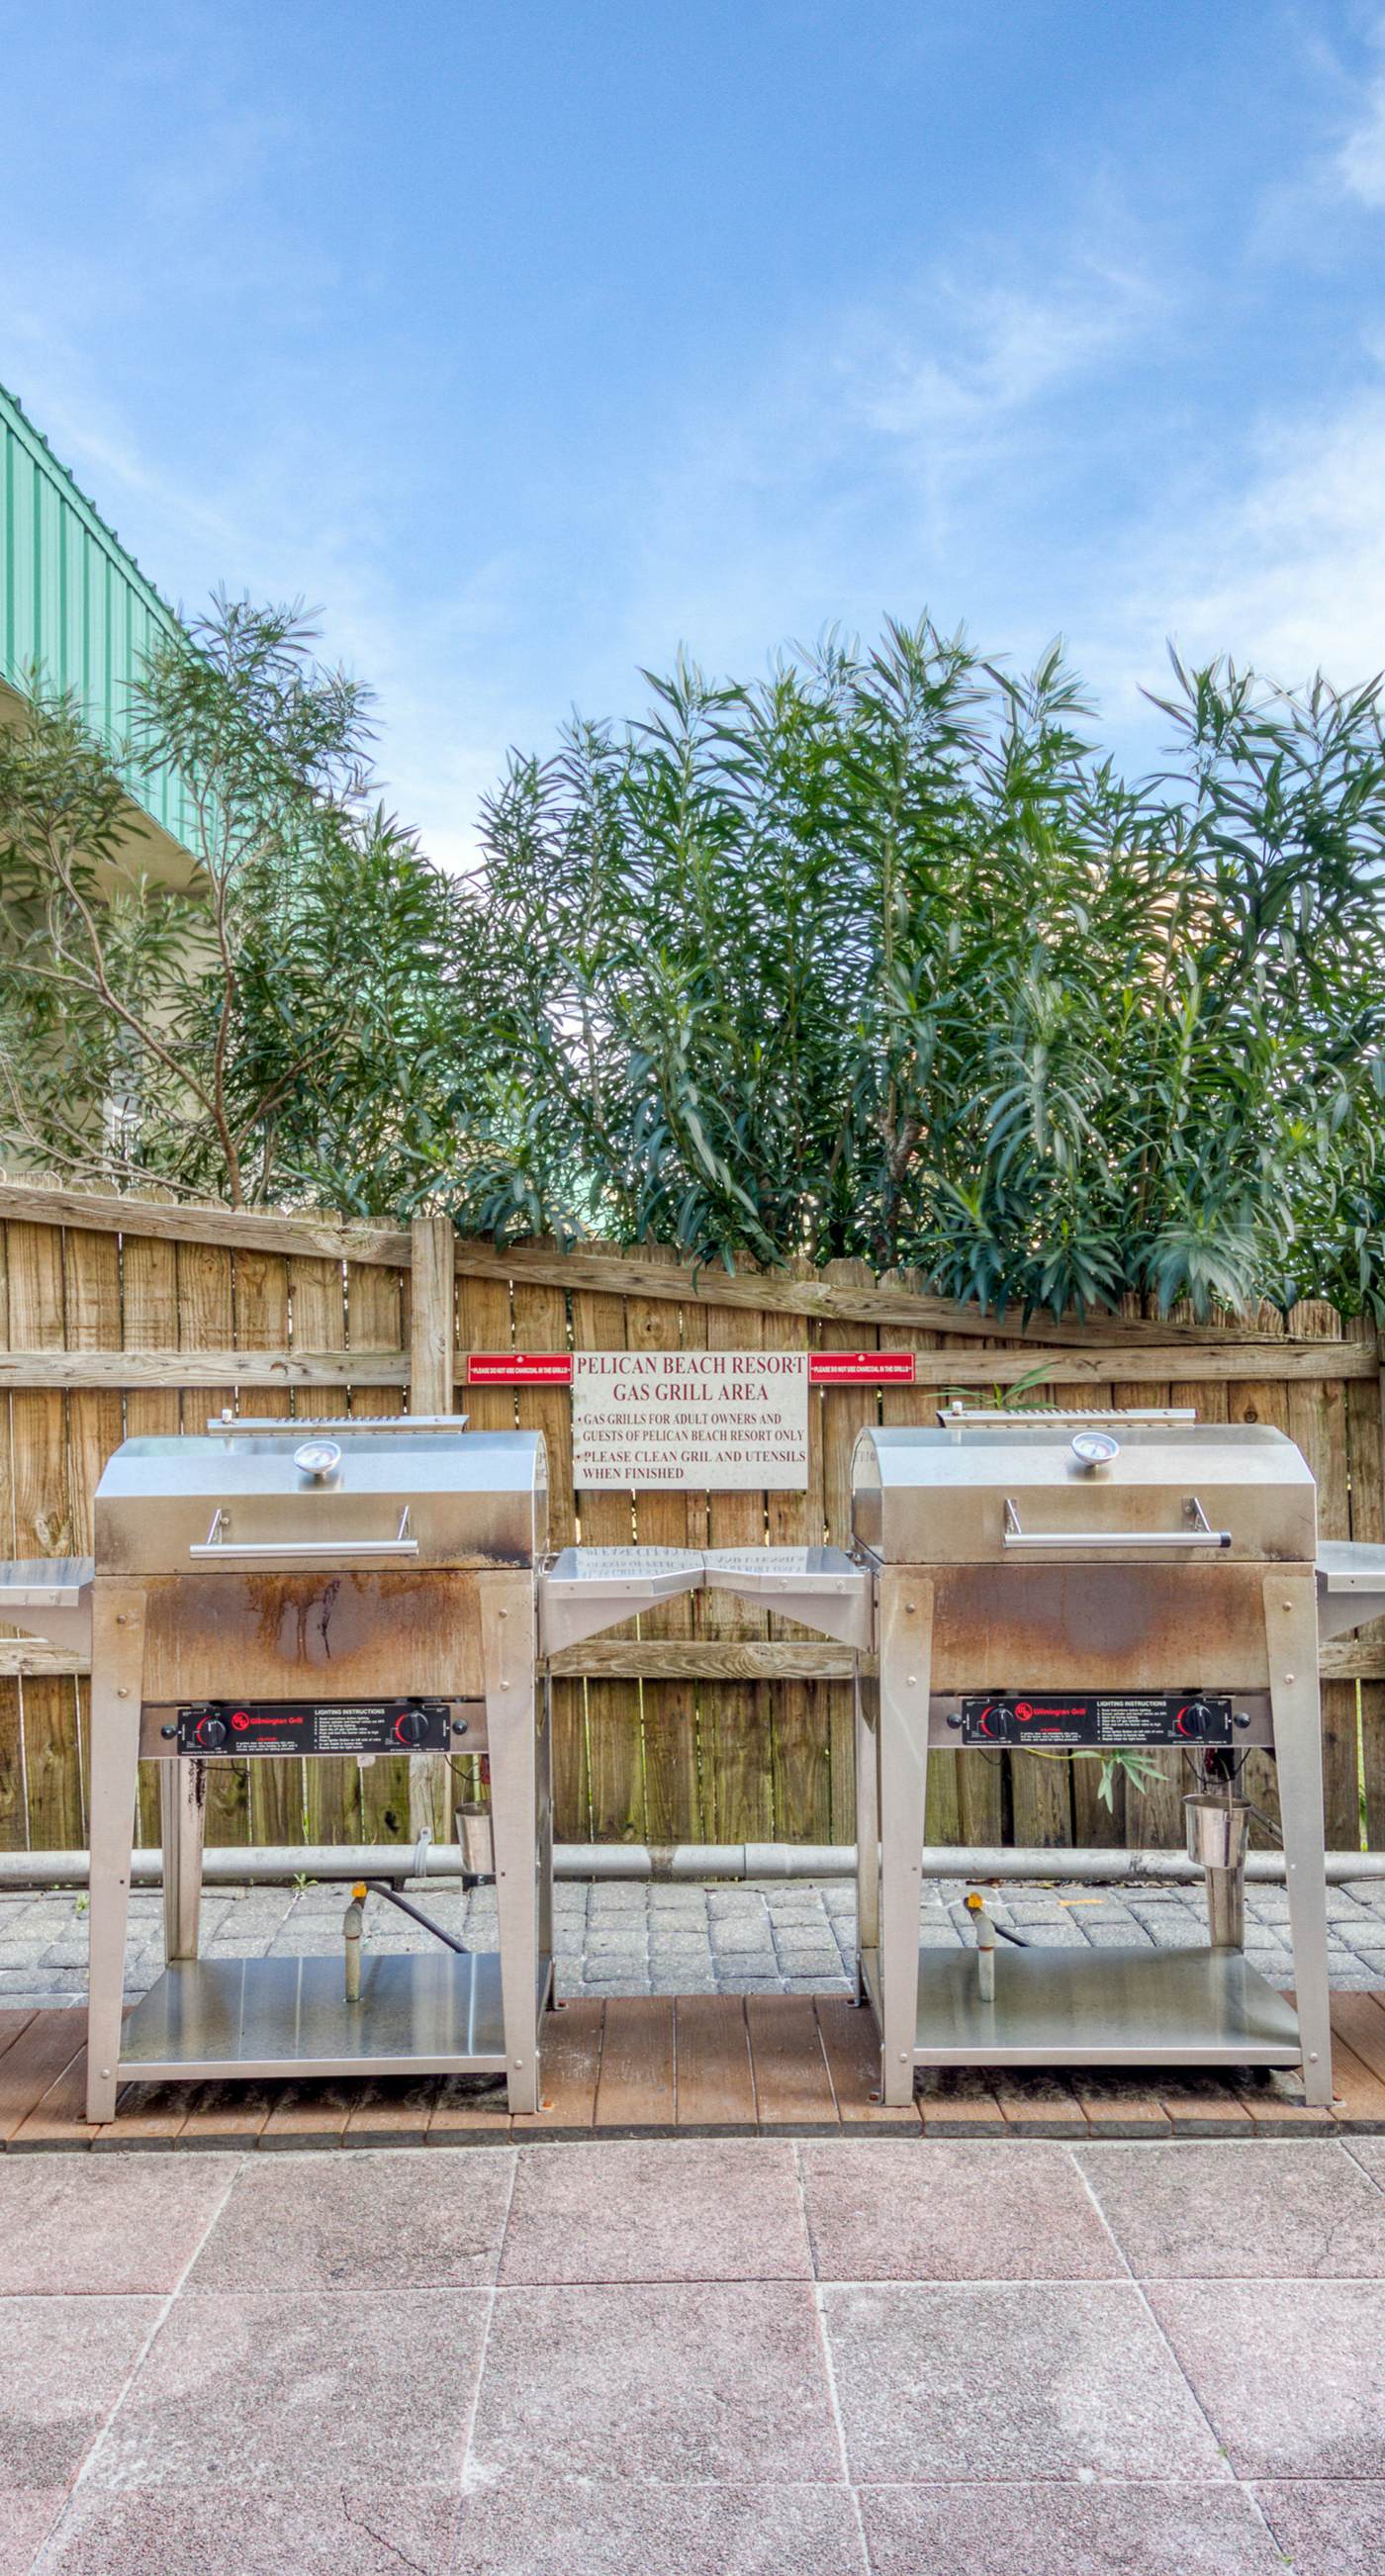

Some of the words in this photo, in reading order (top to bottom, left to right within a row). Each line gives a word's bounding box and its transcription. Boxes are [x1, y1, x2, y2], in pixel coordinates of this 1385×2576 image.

[578, 1357, 657, 1374] PELICAN
[664, 1356, 725, 1374] BEACH
[732, 1356, 805, 1374] RESORT
[613, 1384, 649, 1401] GAS
[655, 1384, 712, 1401] GRILL
[718, 1384, 768, 1400] AREA
[584, 1414, 604, 1425] GAS
[607, 1414, 646, 1425] GRILLS
[649, 1414, 670, 1425] FOR
[674, 1414, 707, 1425] ADULT
[711, 1414, 757, 1425] OWNERS
[760, 1414, 782, 1424] AND
[583, 1430, 623, 1441] GUESTS
[626, 1430, 640, 1440] OF
[643, 1430, 688, 1440] PELICAN
[692, 1430, 726, 1440] BEACH
[731, 1430, 771, 1440] RESORT
[775, 1430, 803, 1440] ONLY
[584, 1451, 630, 1462] PLEASE
[635, 1451, 677, 1462] CLEAN
[716, 1451, 742, 1462] AND
[746, 1451, 805, 1462] UTENSILS
[583, 1468, 620, 1479] WHEN
[625, 1468, 684, 1479] FINISHED
